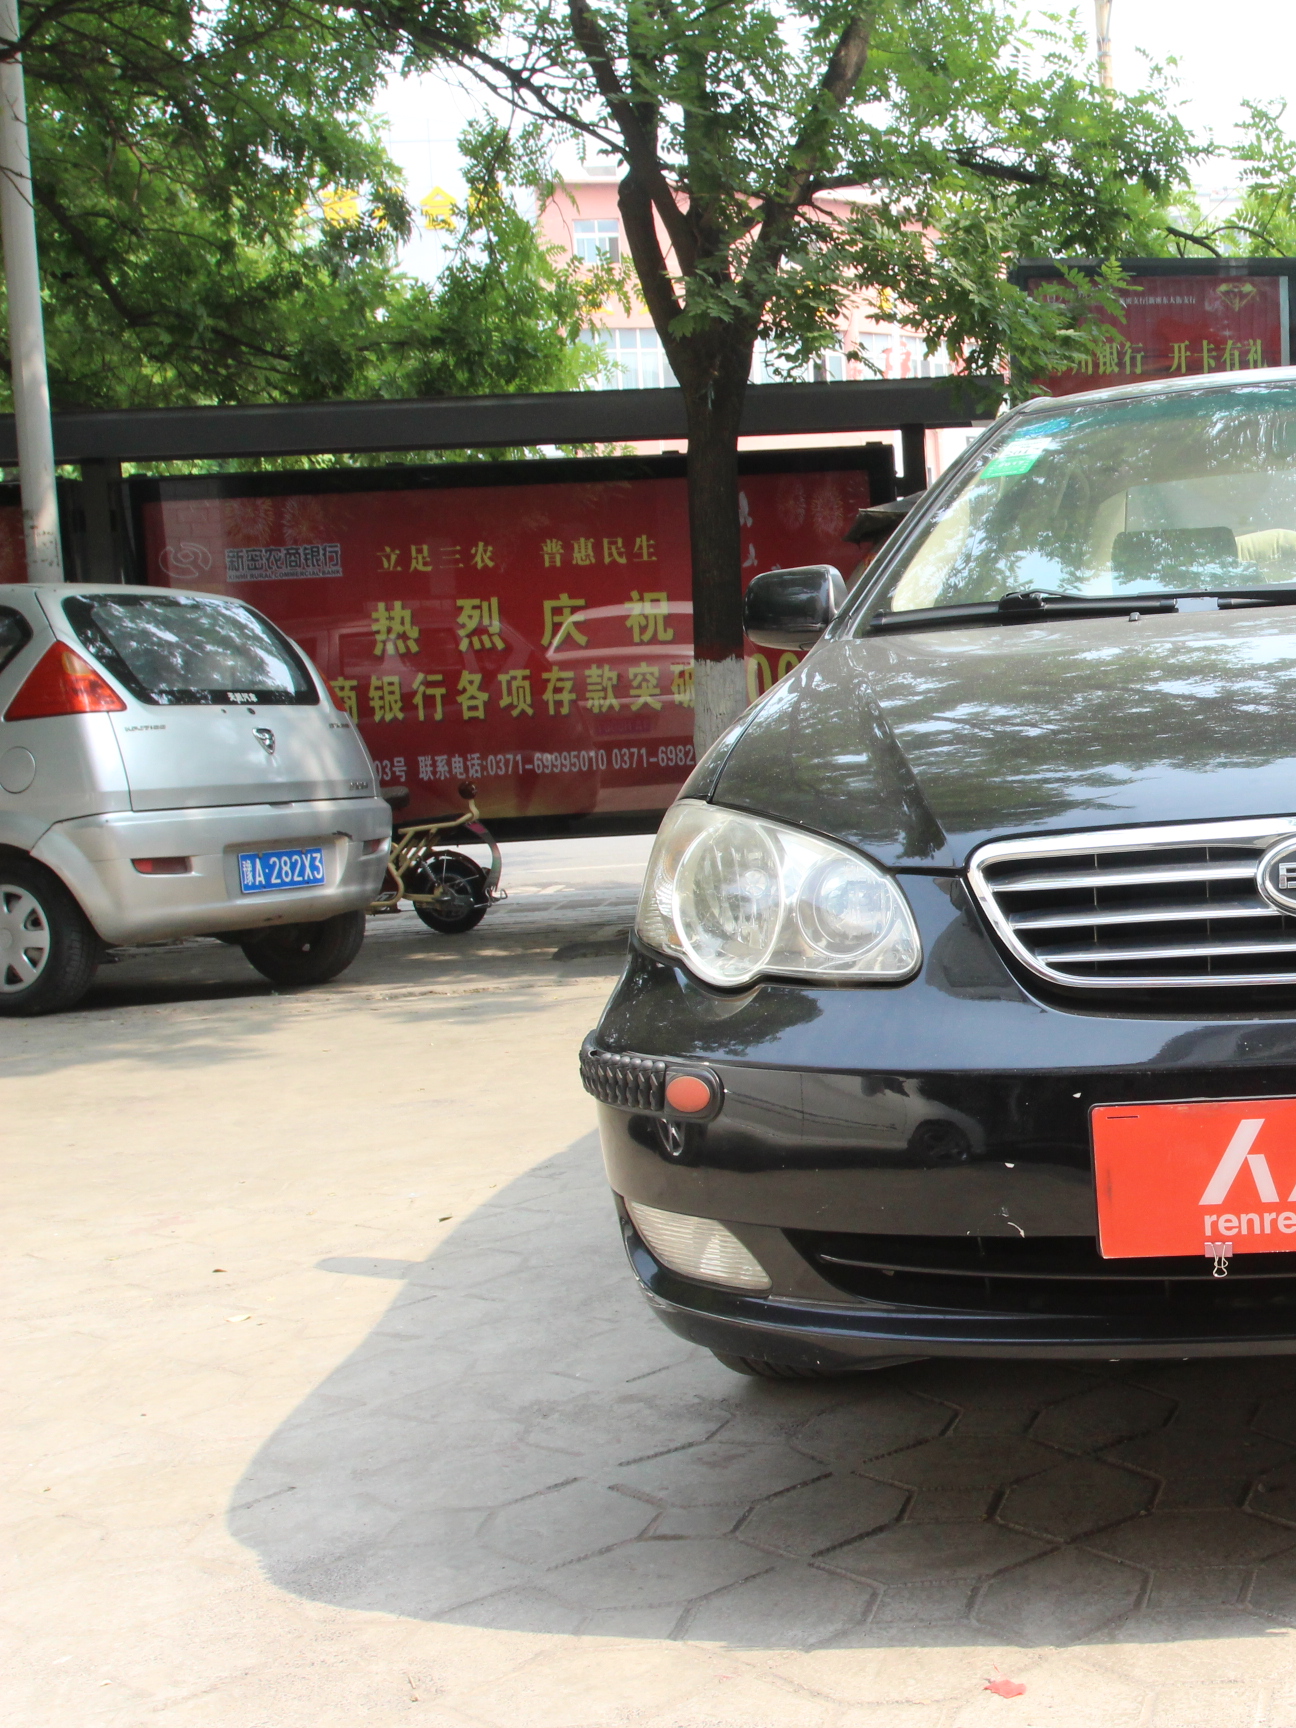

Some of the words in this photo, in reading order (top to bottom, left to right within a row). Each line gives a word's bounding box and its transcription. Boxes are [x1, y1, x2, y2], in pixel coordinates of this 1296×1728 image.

[1052, 341, 1146, 376] 银行
[1168, 339, 1268, 375] 开卡有礼
[227, 545, 340, 572] 新密农商银行
[376, 541, 496, 573] 立足三农
[540, 534, 658, 568] 普惠民生
[250, 571, 272, 579] RURAL
[274, 570, 320, 578] COMMERCIAL
[321, 568, 341, 576] BANK
[371, 590, 675, 657] 热烈庆祝
